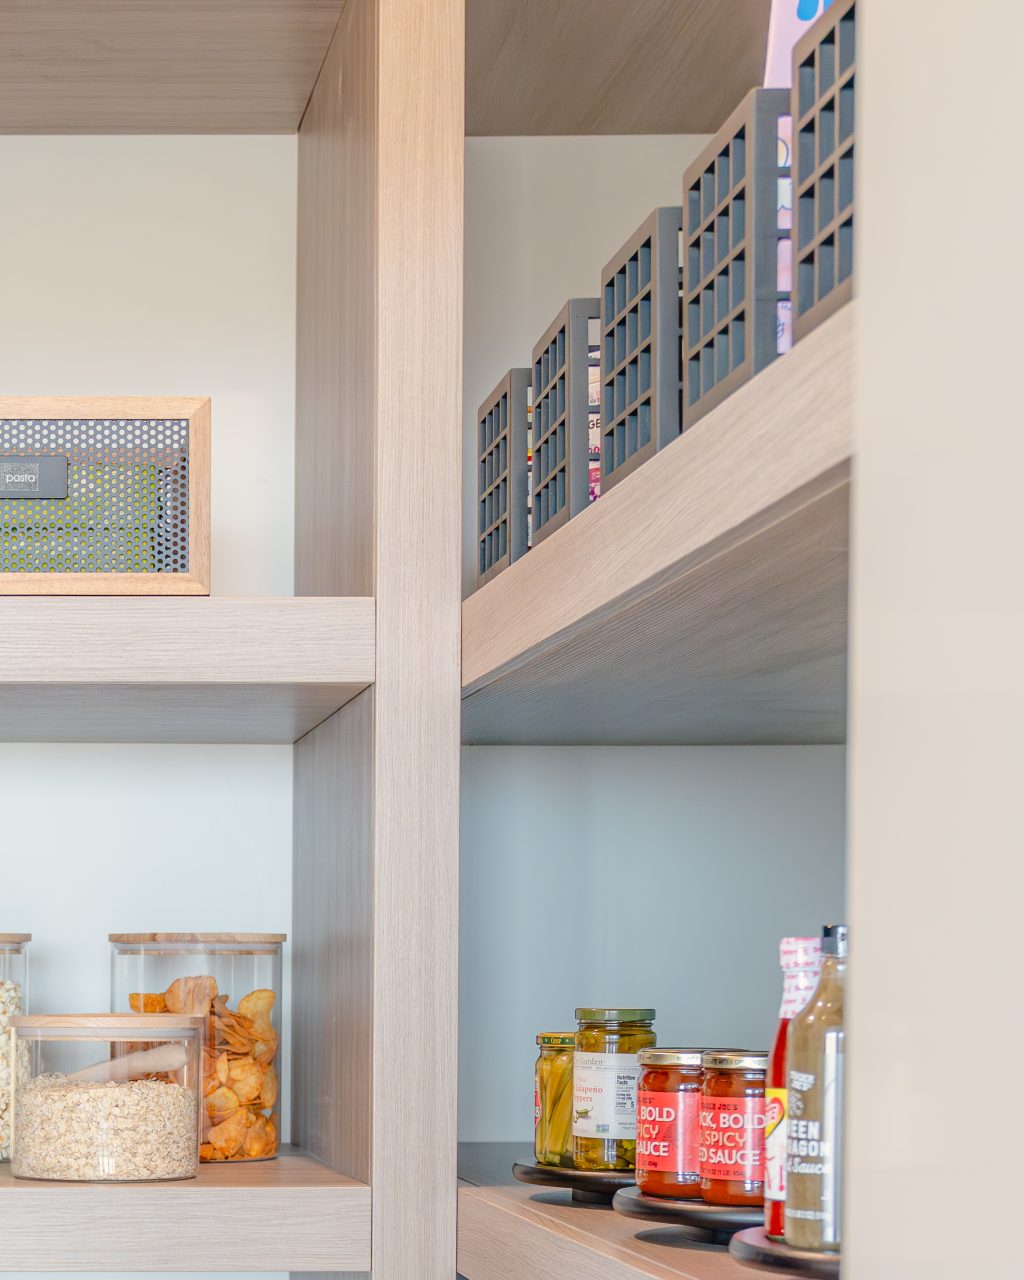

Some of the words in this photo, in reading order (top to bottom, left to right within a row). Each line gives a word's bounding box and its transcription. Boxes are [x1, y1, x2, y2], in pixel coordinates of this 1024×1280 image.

[5, 473, 36, 484] pasta
[641, 1107, 675, 1122] BOLD
[720, 1114, 765, 1129] BOLD
[787, 1118, 820, 1140] EEN
[705, 1131, 747, 1147] SPICY
[709, 1148, 760, 1165] SAUCE
